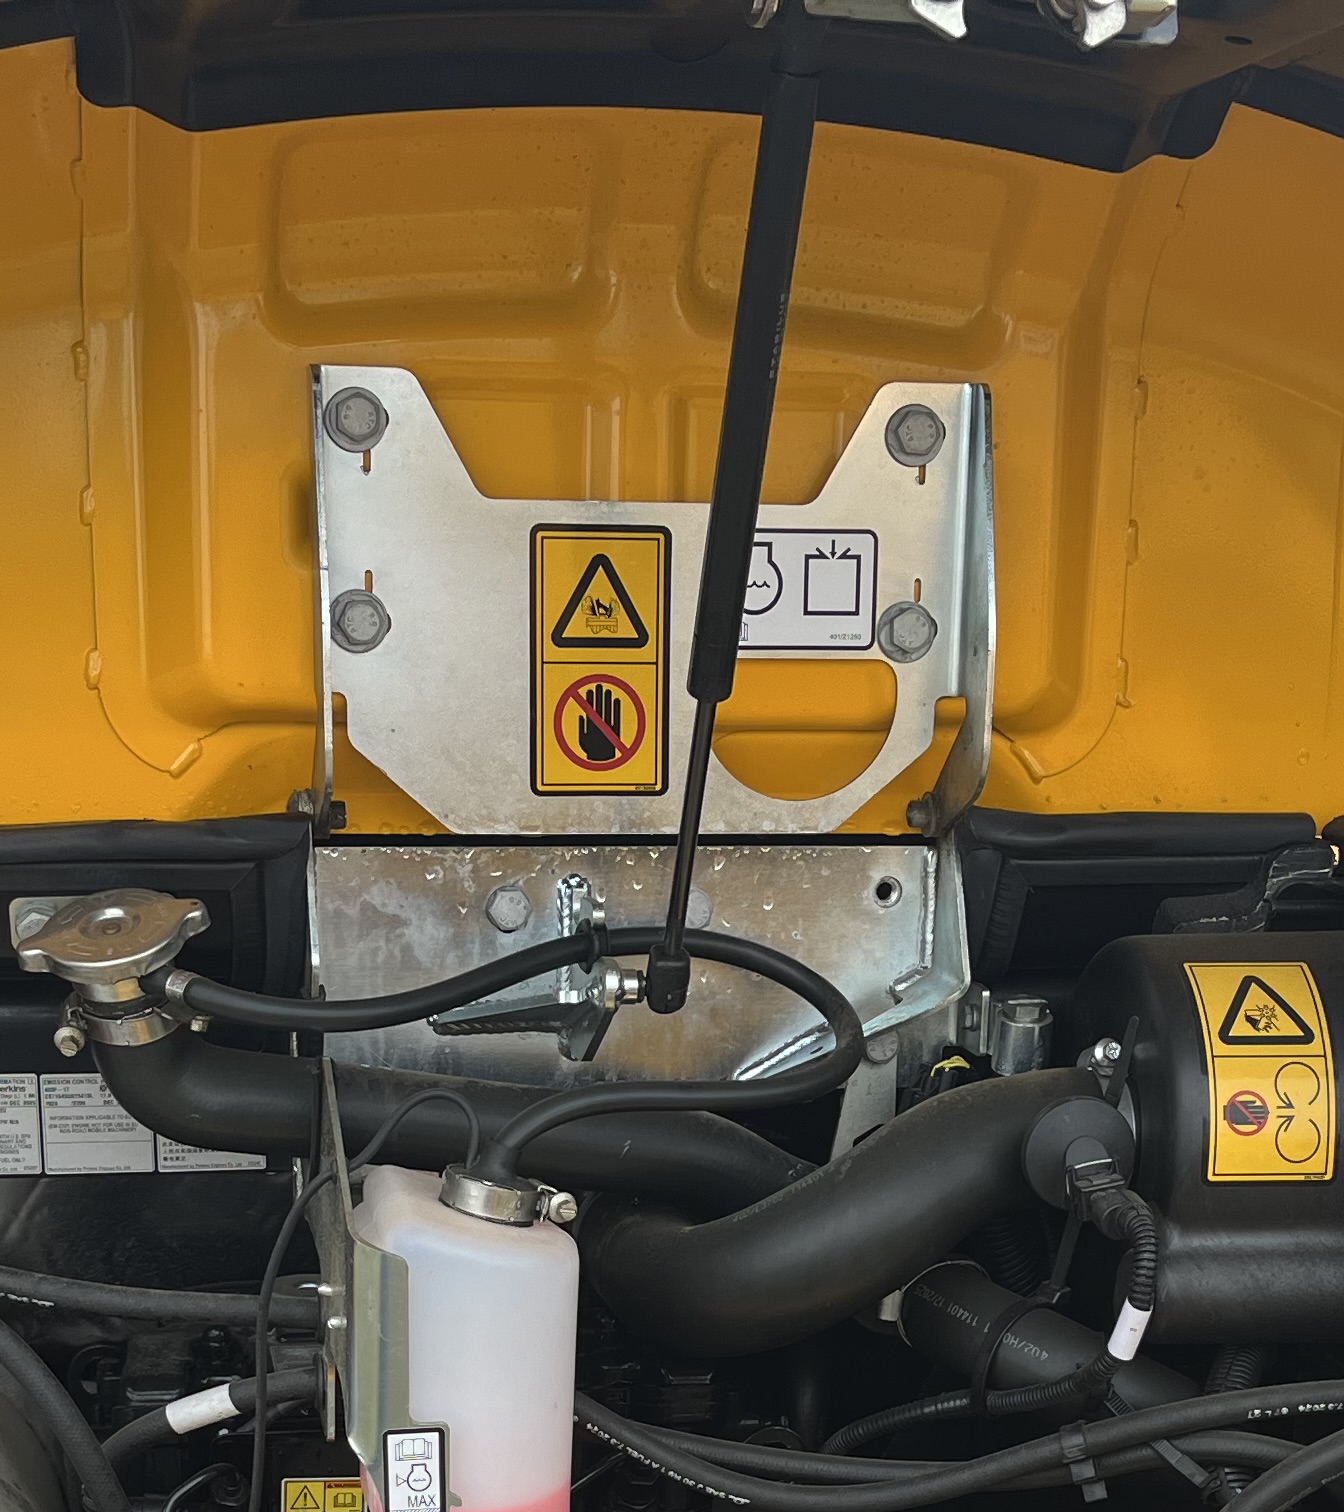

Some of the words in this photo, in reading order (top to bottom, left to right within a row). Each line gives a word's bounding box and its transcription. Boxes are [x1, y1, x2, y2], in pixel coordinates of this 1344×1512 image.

[585, 1421, 610, 1441] 2024
[625, 1445, 651, 1464] FUEL
[407, 1494, 437, 1508] MAX
